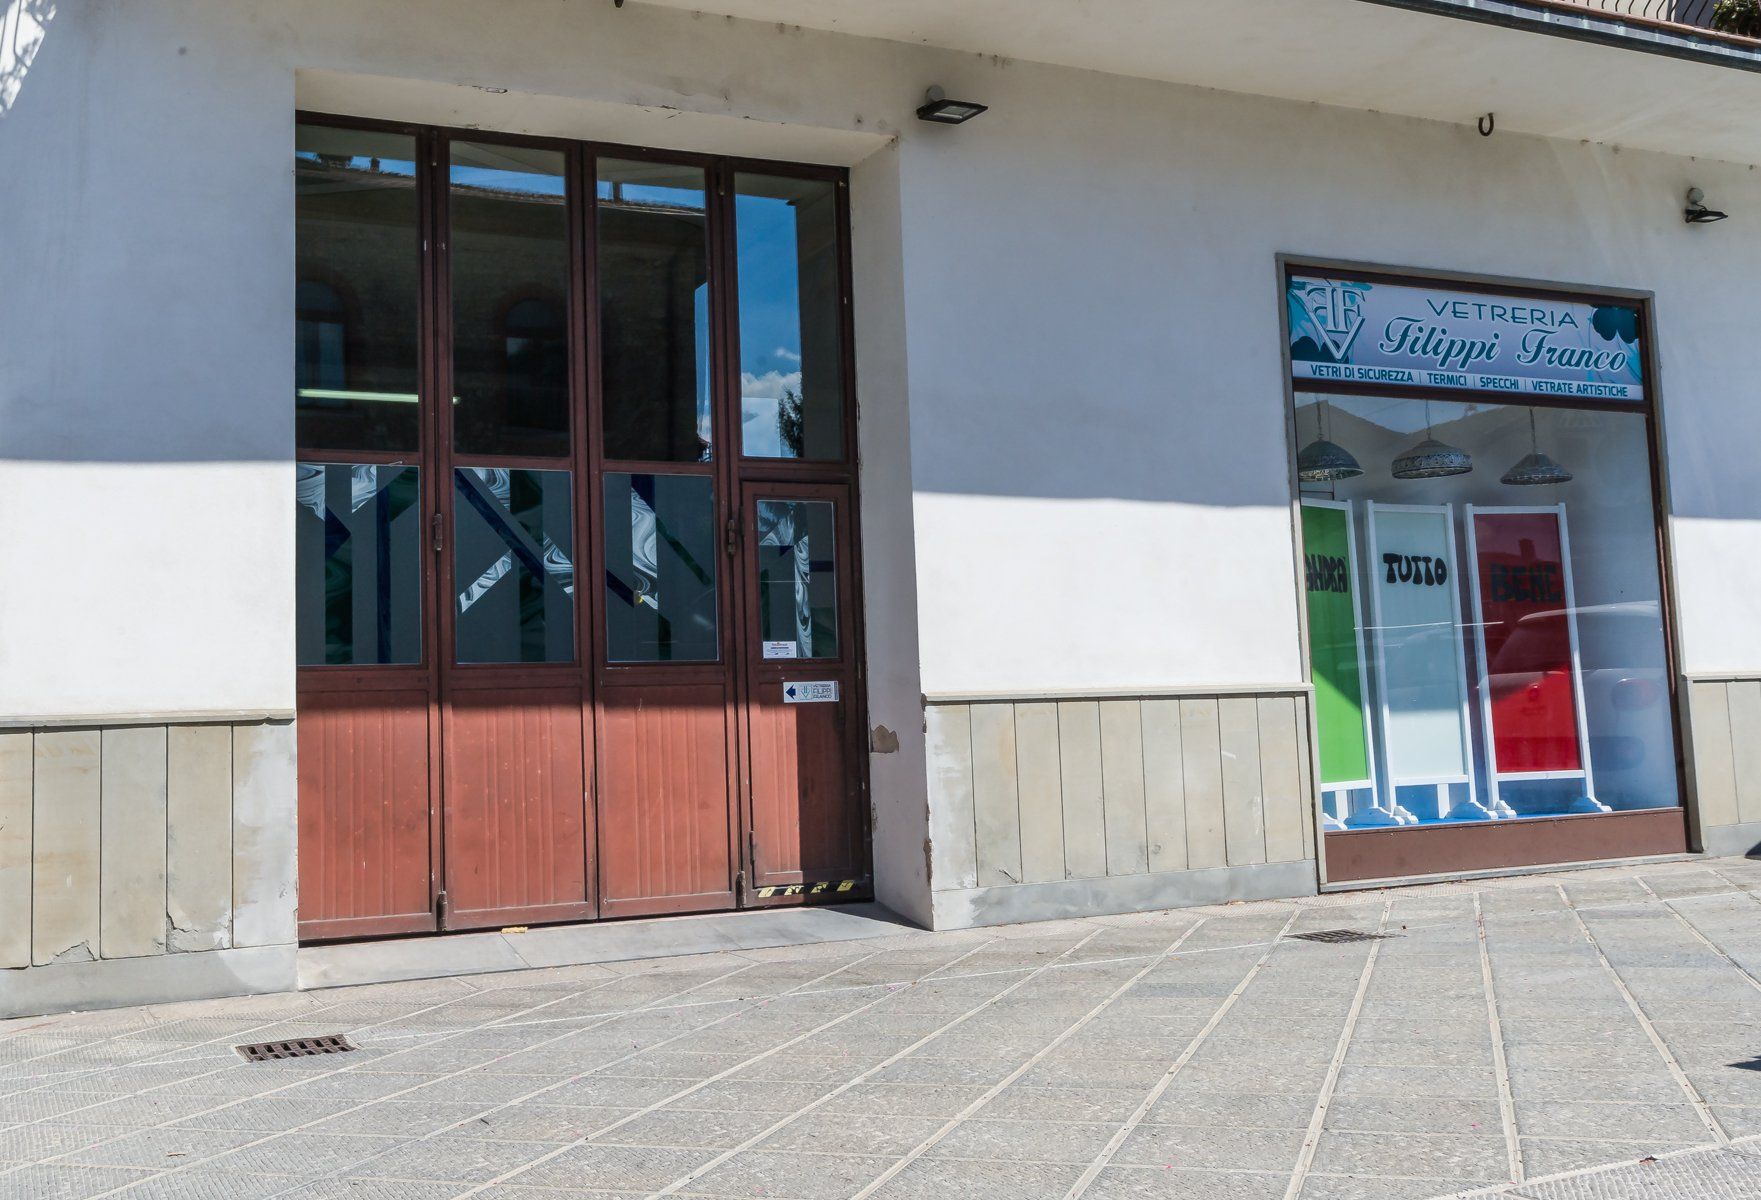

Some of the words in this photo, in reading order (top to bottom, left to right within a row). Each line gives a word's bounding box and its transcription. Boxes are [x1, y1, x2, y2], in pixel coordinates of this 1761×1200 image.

[1426, 298, 1579, 329] VETRERIA
[1379, 316, 1500, 369] Filippi
[1516, 328, 1626, 371] Franco
[1310, 364, 1341, 378] VETRI
[1344, 366, 1355, 379] DI
[1357, 367, 1414, 383] SICUREZZA
[1427, 372, 1467, 386] TERMICI
[1479, 376, 1519, 390] SPECCHI
[1531, 380, 1574, 394] VETRATE
[1576, 383, 1628, 397] ARTISTICHE
[1383, 553, 1448, 586] TUTTO
[1489, 562, 1561, 603] BENE
